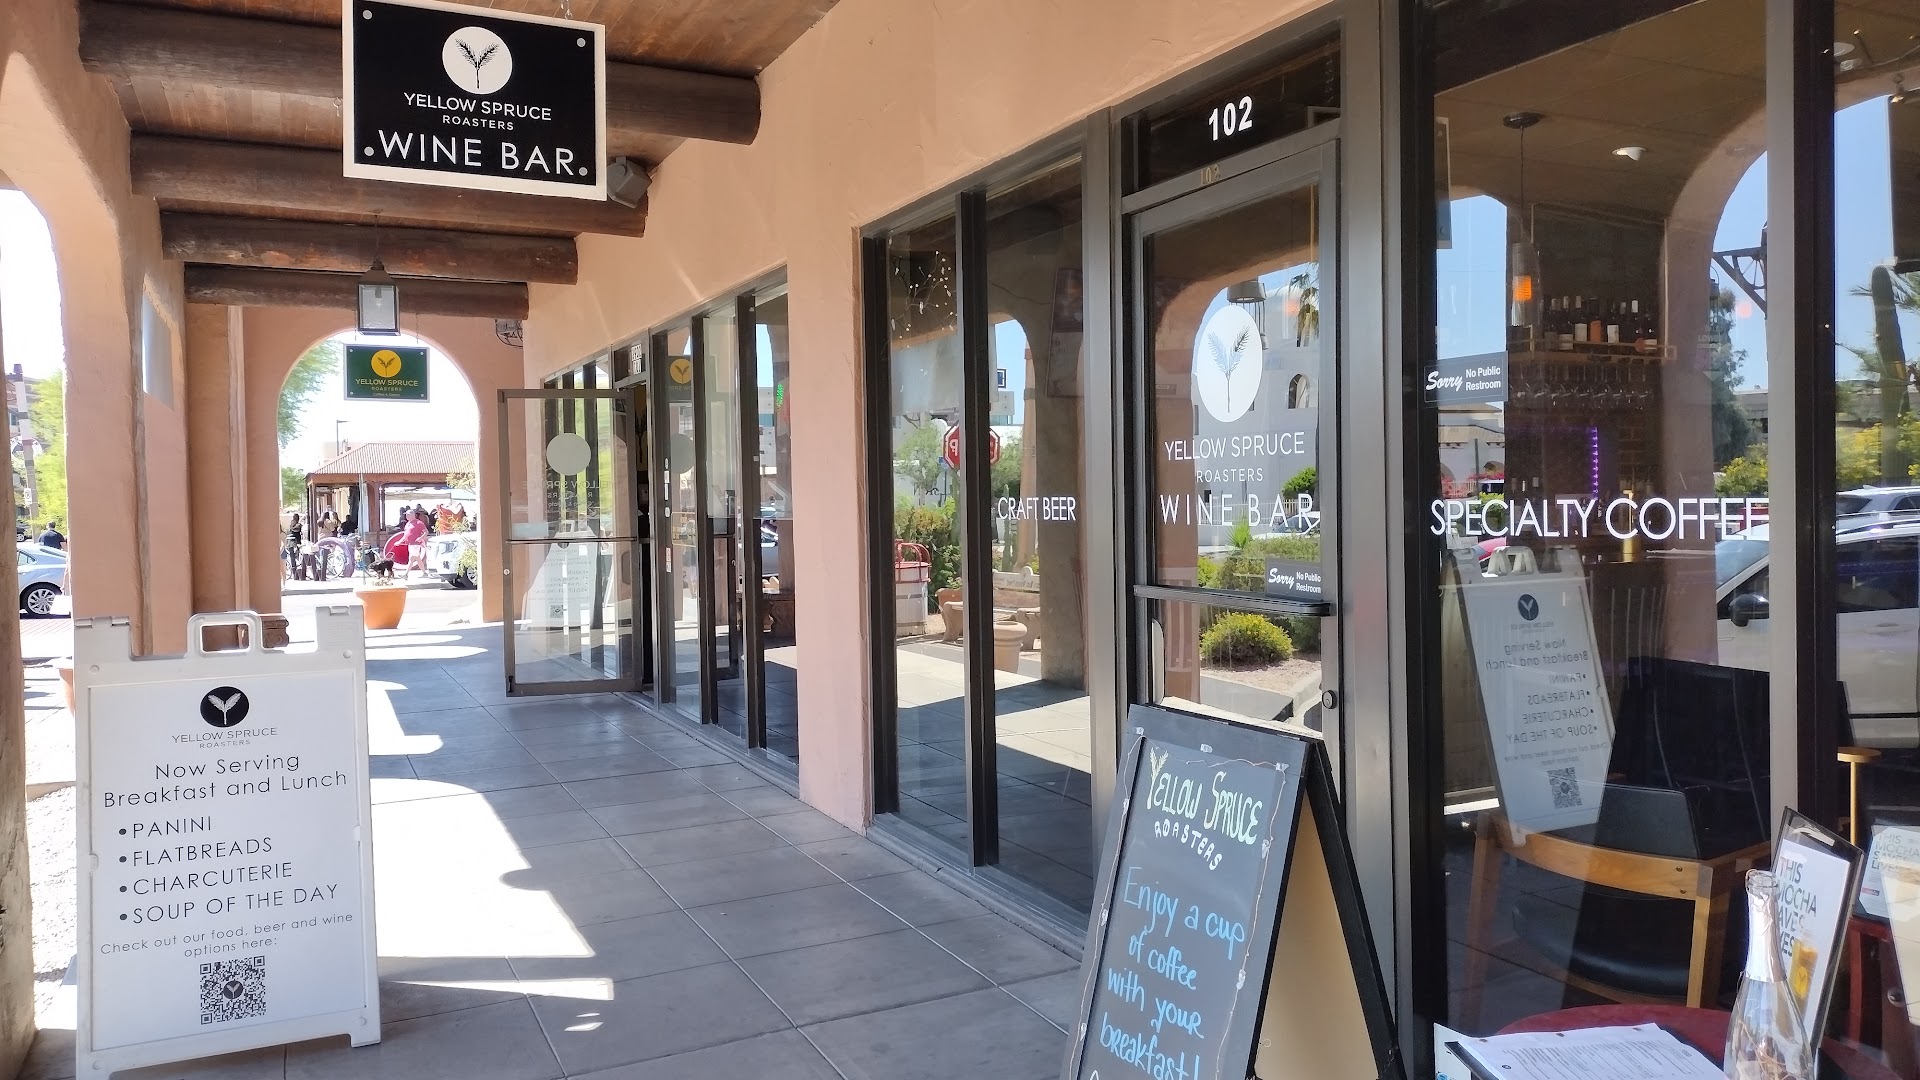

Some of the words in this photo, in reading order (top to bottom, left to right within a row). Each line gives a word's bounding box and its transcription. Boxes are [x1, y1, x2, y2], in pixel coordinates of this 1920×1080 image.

[404, 92, 476, 113] YELLOW
[481, 101, 552, 121] SPRUCE
[1208, 96, 1253, 141] 102
[442, 114, 514, 131] ROASTERS
[378, 129, 482, 167] WINE
[501, 142, 575, 176] BAR
[1200, 164, 1221, 185] 102
[1426, 371, 1463, 392] Sorry
[1465, 368, 1475, 379] No
[1477, 366, 1501, 377] Public
[1465, 379, 1501, 391] Restroom
[1165, 437, 1227, 461] YELLOW
[1231, 432, 1305, 458] SPRUCE
[1196, 468, 1264, 483] ROASTERS
[998, 497, 1039, 521] CRAFT
[1042, 497, 1076, 521] BEER
[1160, 494, 1233, 526] WINE
[1248, 494, 1313, 529] BAR
[1430, 499, 1592, 538] SPECIALTY
[1605, 497, 1770, 540] COFFEE
[1268, 567, 1295, 589] Sorry
[1296, 571, 1304, 580] No
[1305, 572, 1321, 582] Public
[1296, 583, 1321, 593] Restroom
[172, 731, 223, 743] YELLOW
[227, 727, 278, 740] SPRUCE
[199, 739, 251, 749] ROASTERS
[155, 763, 207, 780] Now
[216, 754, 300, 774] Serving
[104, 781, 215, 808] Breakfast
[226, 777, 270, 796] and
[282, 770, 347, 791] Lunch
[1147, 747, 1203, 820] YELLOW
[1203, 771, 1263, 845] SPRUCE
[133, 816, 212, 838] PANINI
[1879, 834, 1901, 844] THIS
[133, 837, 272, 867] FLATBREADS
[1155, 819, 1222, 871] ROASTERS
[1876, 841, 1919, 857] MOCHA
[133, 862, 293, 896] CHARCUTERIE
[1779, 856, 1803, 884] THIS
[133, 901, 195, 924] SOUP
[206, 896, 236, 915] OF
[246, 890, 283, 910] THE
[294, 883, 338, 904] DAY
[1124, 867, 1179, 937] Enjoy
[1184, 906, 1199, 930] a
[1206, 912, 1245, 960] cup
[1778, 906, 1805, 932] AVES
[101, 939, 148, 955] Check
[154, 935, 177, 948] out
[183, 932, 206, 944] our
[211, 926, 248, 940] food,
[254, 921, 286, 935] beer
[291, 916, 317, 929] and
[322, 912, 353, 925] wine
[184, 943, 236, 959] options
[242, 936, 278, 949] here:
[1129, 930, 1147, 963] of
[1148, 946, 1197, 990] coffee
[1108, 968, 1145, 1011] with
